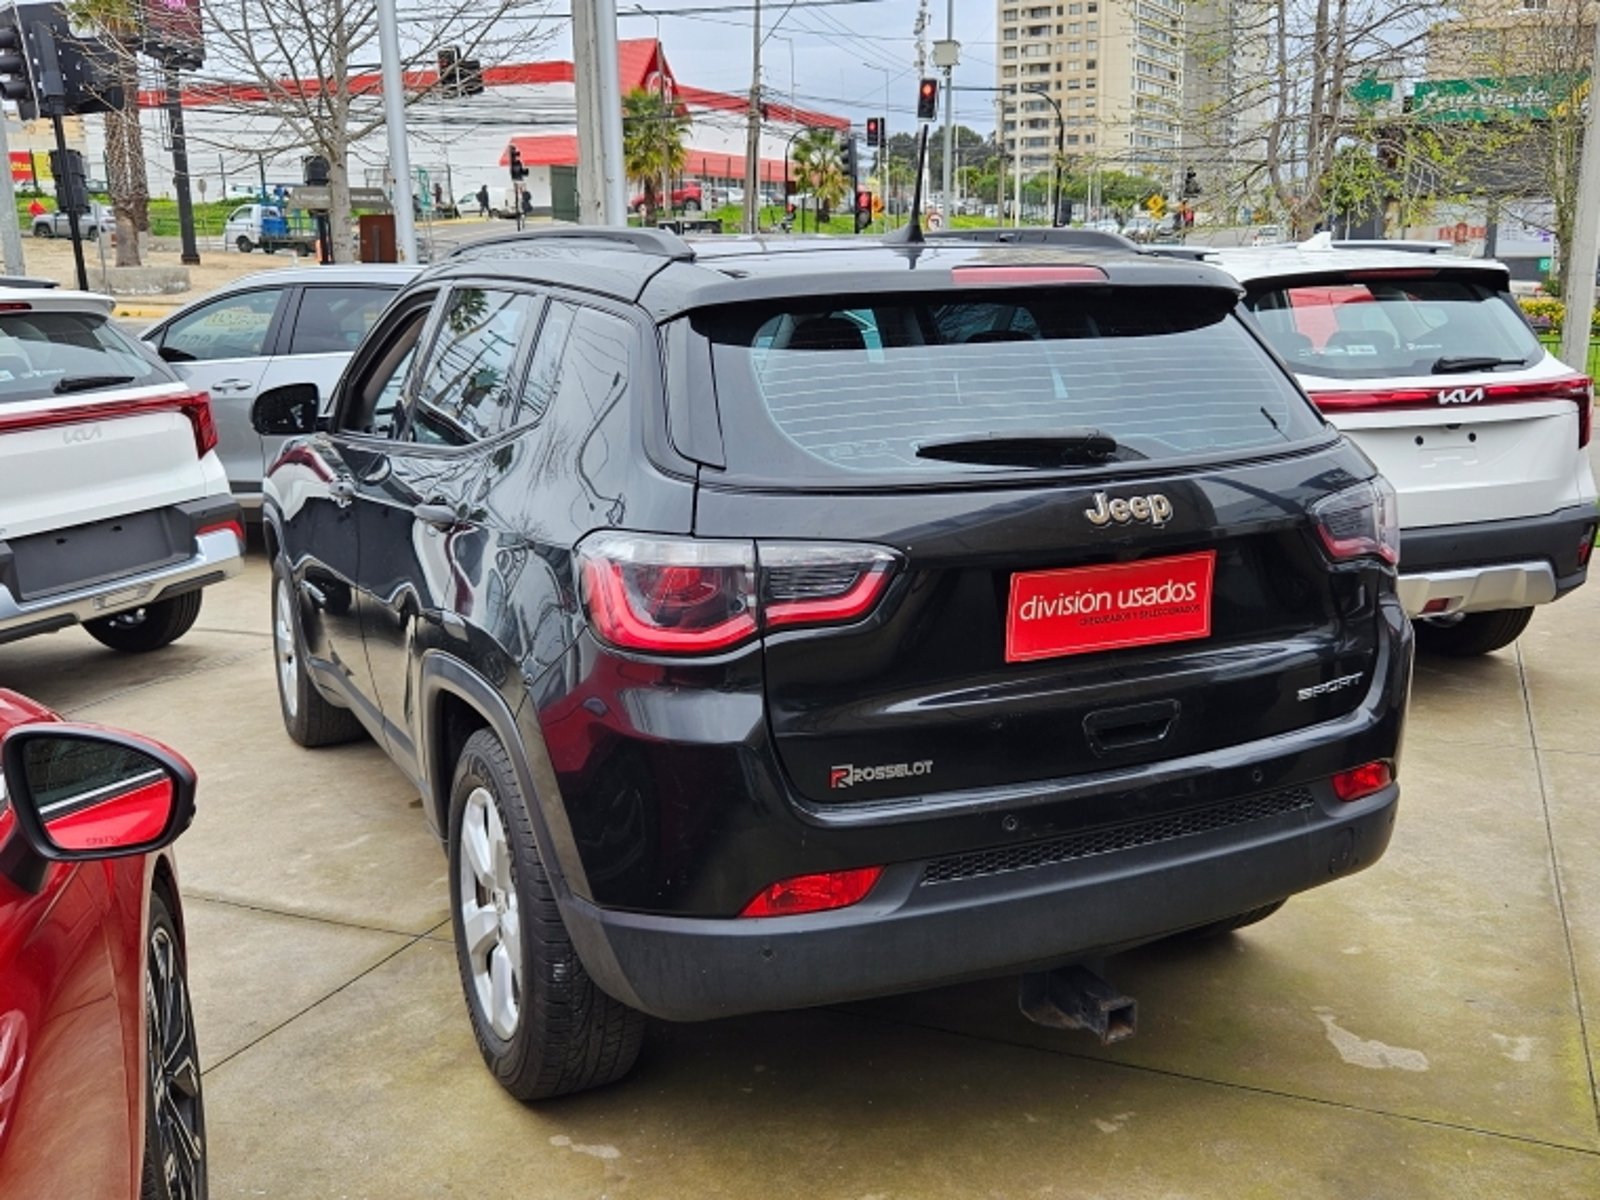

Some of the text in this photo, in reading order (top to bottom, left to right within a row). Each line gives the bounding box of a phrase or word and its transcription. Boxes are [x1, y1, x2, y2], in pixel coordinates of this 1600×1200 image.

[1437, 387, 1484, 405] KIA
[1084, 492, 1173, 525] Jeep
[1019, 579, 1197, 621] división usados
[1298, 671, 1363, 701] SPORT
